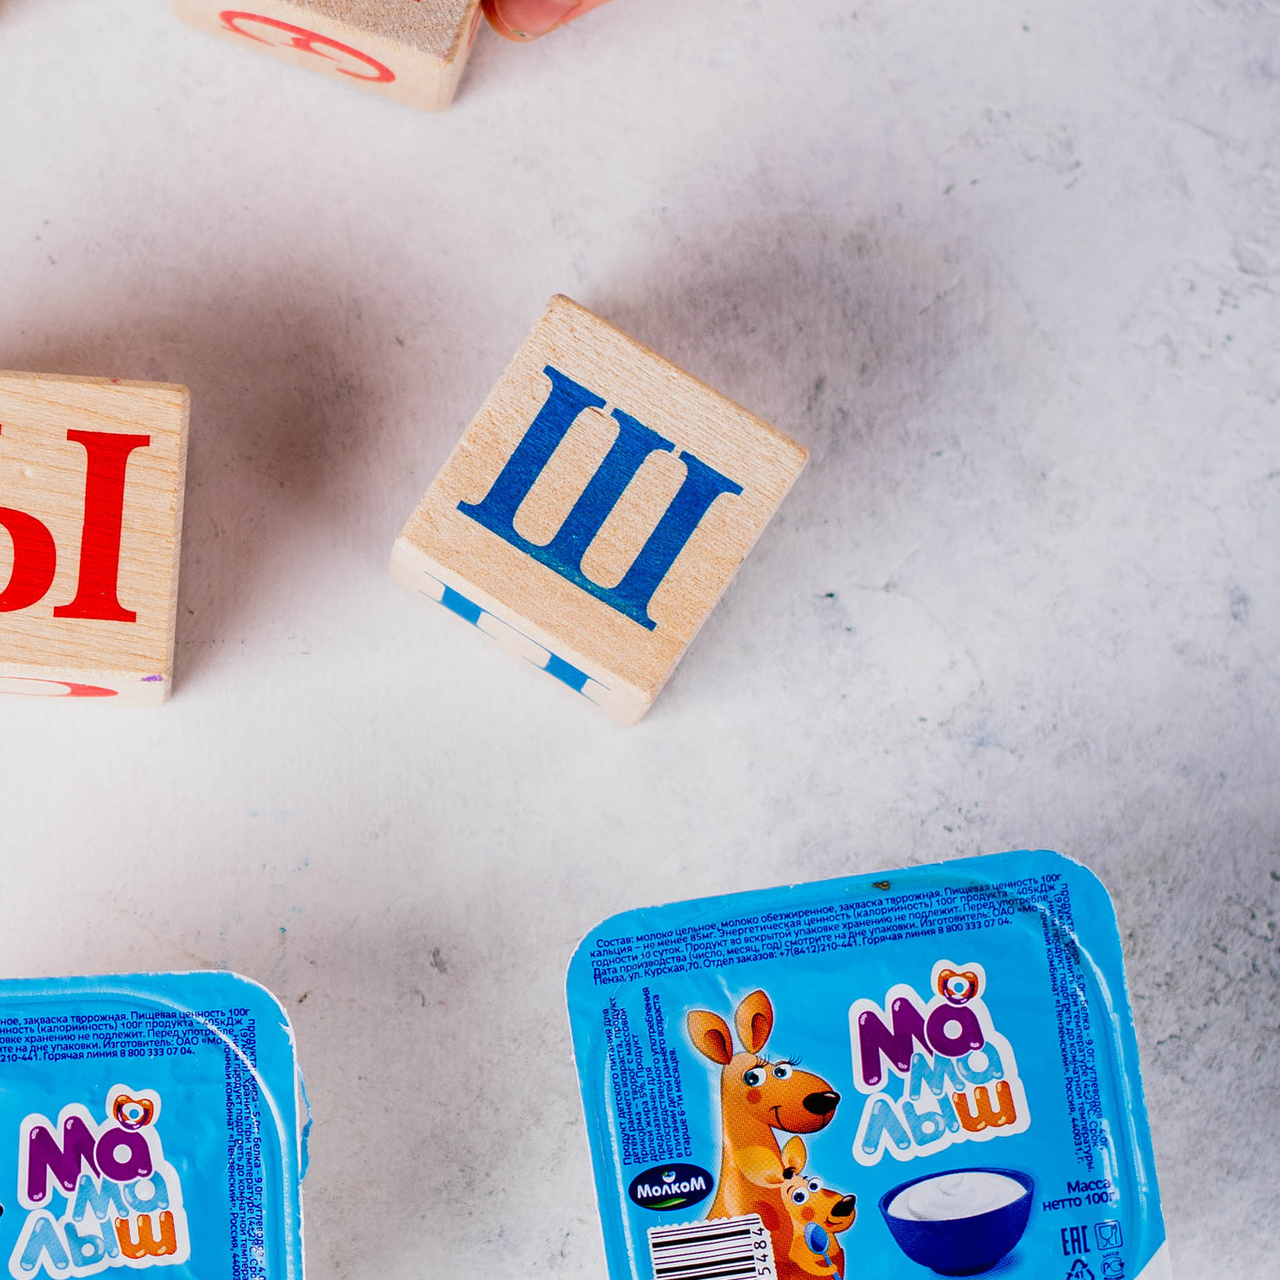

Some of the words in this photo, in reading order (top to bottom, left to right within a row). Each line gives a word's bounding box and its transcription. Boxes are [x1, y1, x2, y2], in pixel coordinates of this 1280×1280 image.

[457, 365, 743, 630] Ш
[23, 1015, 68, 1025] закваска
[71, 1013, 128, 1024] творожная.
[130, 1008, 177, 1022] Пищевая
[179, 1009, 225, 1020] ценность
[227, 1007, 250, 1017] 100г
[120, 1019, 144, 1029] 100г
[145, 1018, 193, 1030] продукта
[23, 1033, 76, 1044] хранению
[92, 1030, 145, 1041] подлежит.
[147, 1027, 179, 1039] Перед
[29, 1044, 49, 1055] дне
[51, 1041, 101, 1053] упаковки.
[103, 1036, 173, 1049] Изготовитель:
[175, 1035, 199, 1046] ОАО
[43, 1049, 84, 1063] Горячая
[86, 1050, 118, 1058] линия
[119, 1049, 127, 1057] 8
[127, 1048, 146, 1057] 800
[147, 1047, 166, 1056] 333
[165, 1046, 178, 1055] 07
[179, 1046, 196, 1055] 04.
[1066, 1178, 1112, 1194] Масса
[1042, 1196, 1083, 1211] нетто
